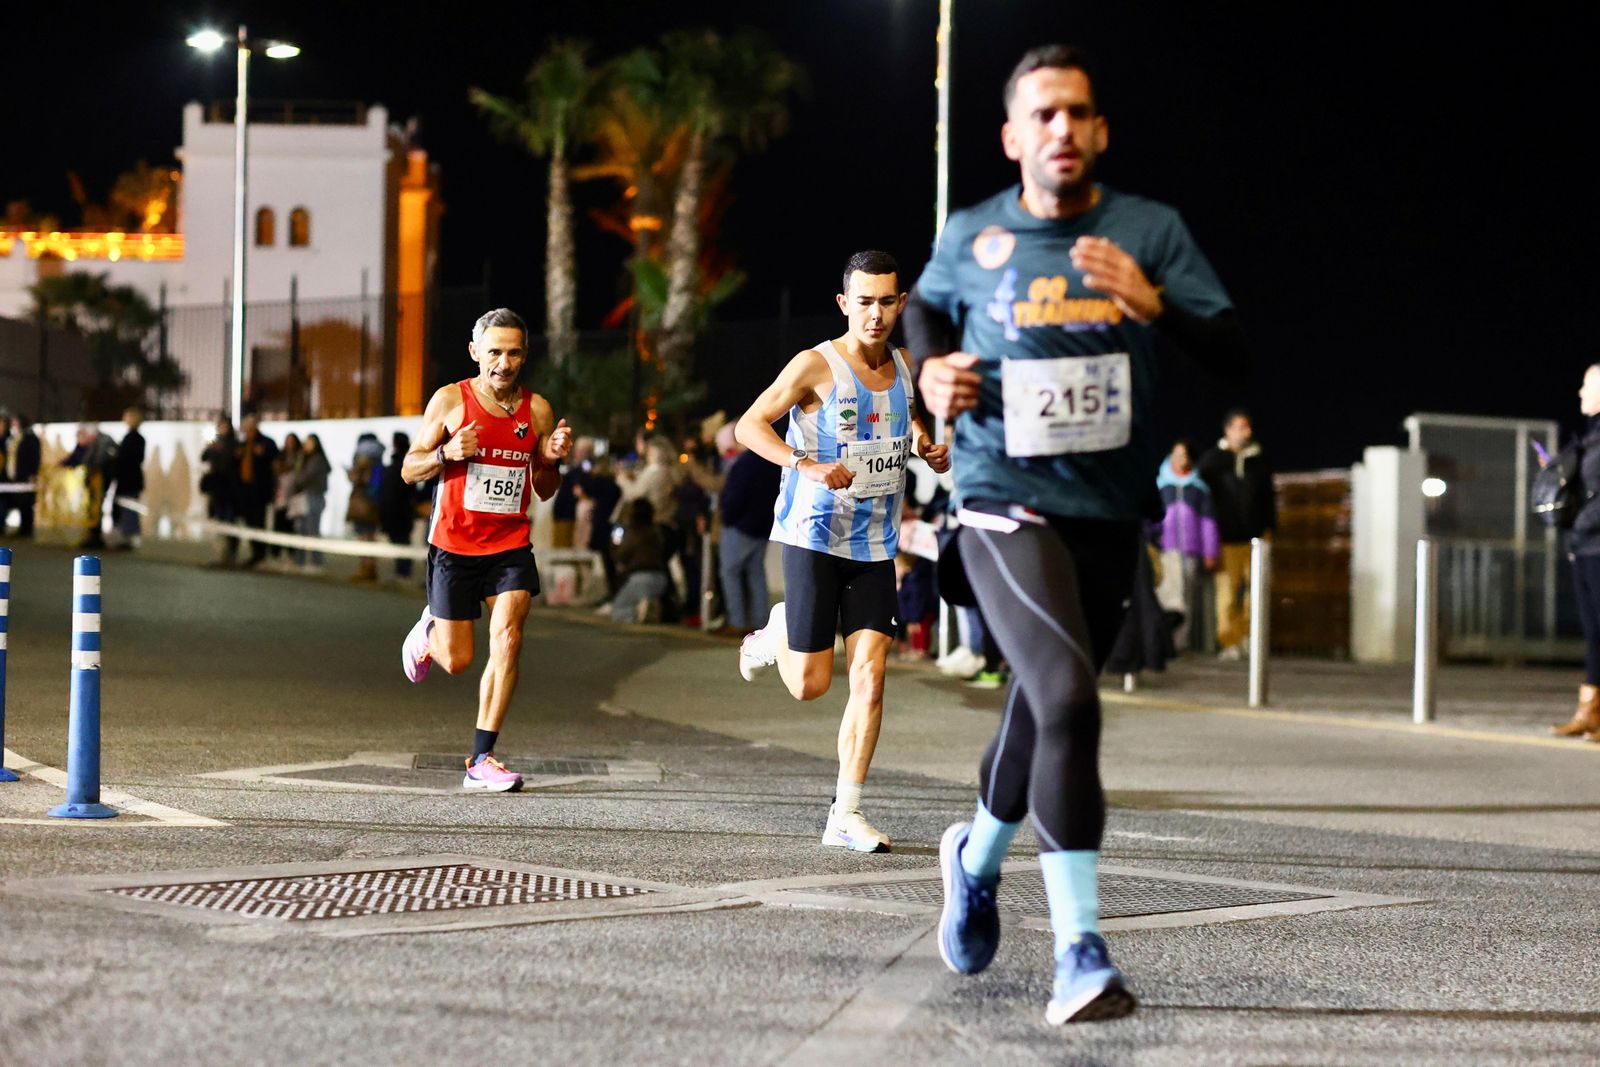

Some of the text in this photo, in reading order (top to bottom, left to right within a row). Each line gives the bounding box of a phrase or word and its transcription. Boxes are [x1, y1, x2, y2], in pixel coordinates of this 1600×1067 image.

[1039, 385, 1101, 416] 215
[893, 441, 901, 450] M
[492, 448, 531, 462] PEDR
[866, 455, 901, 473] 1044
[508, 470, 516, 478] M
[483, 479, 514, 496] 158
